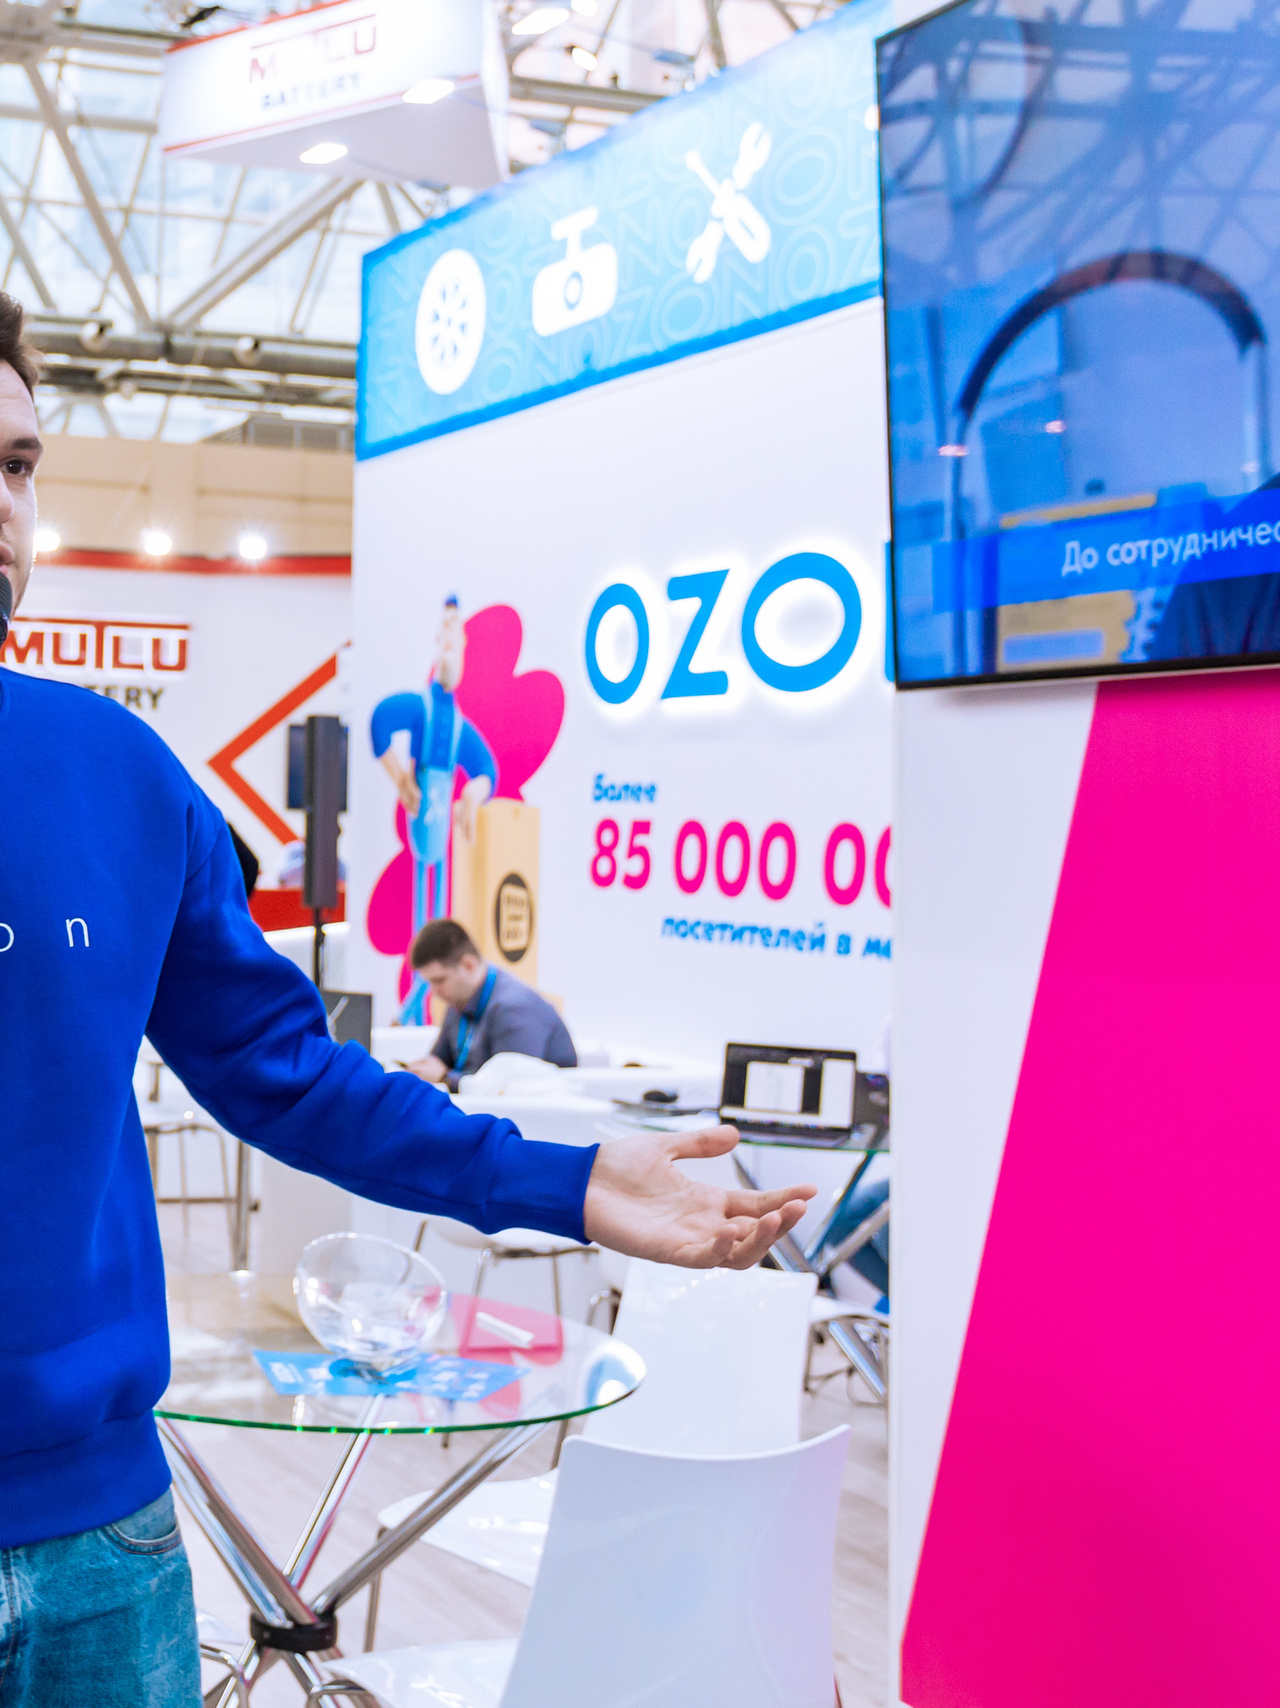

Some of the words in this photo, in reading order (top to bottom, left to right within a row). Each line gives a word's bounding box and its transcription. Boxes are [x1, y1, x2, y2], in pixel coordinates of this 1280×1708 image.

[248, 13, 377, 83] MTLU
[1061, 540, 1099, 577] До
[0, 616, 190, 672] MUTLU
[585, 542, 895, 704] OZO
[593, 773, 656, 803] Более
[590, 819, 652, 889] 85
[674, 820, 797, 901] 000
[661, 917, 826, 952] посетителей
[836, 933, 852, 956] в
